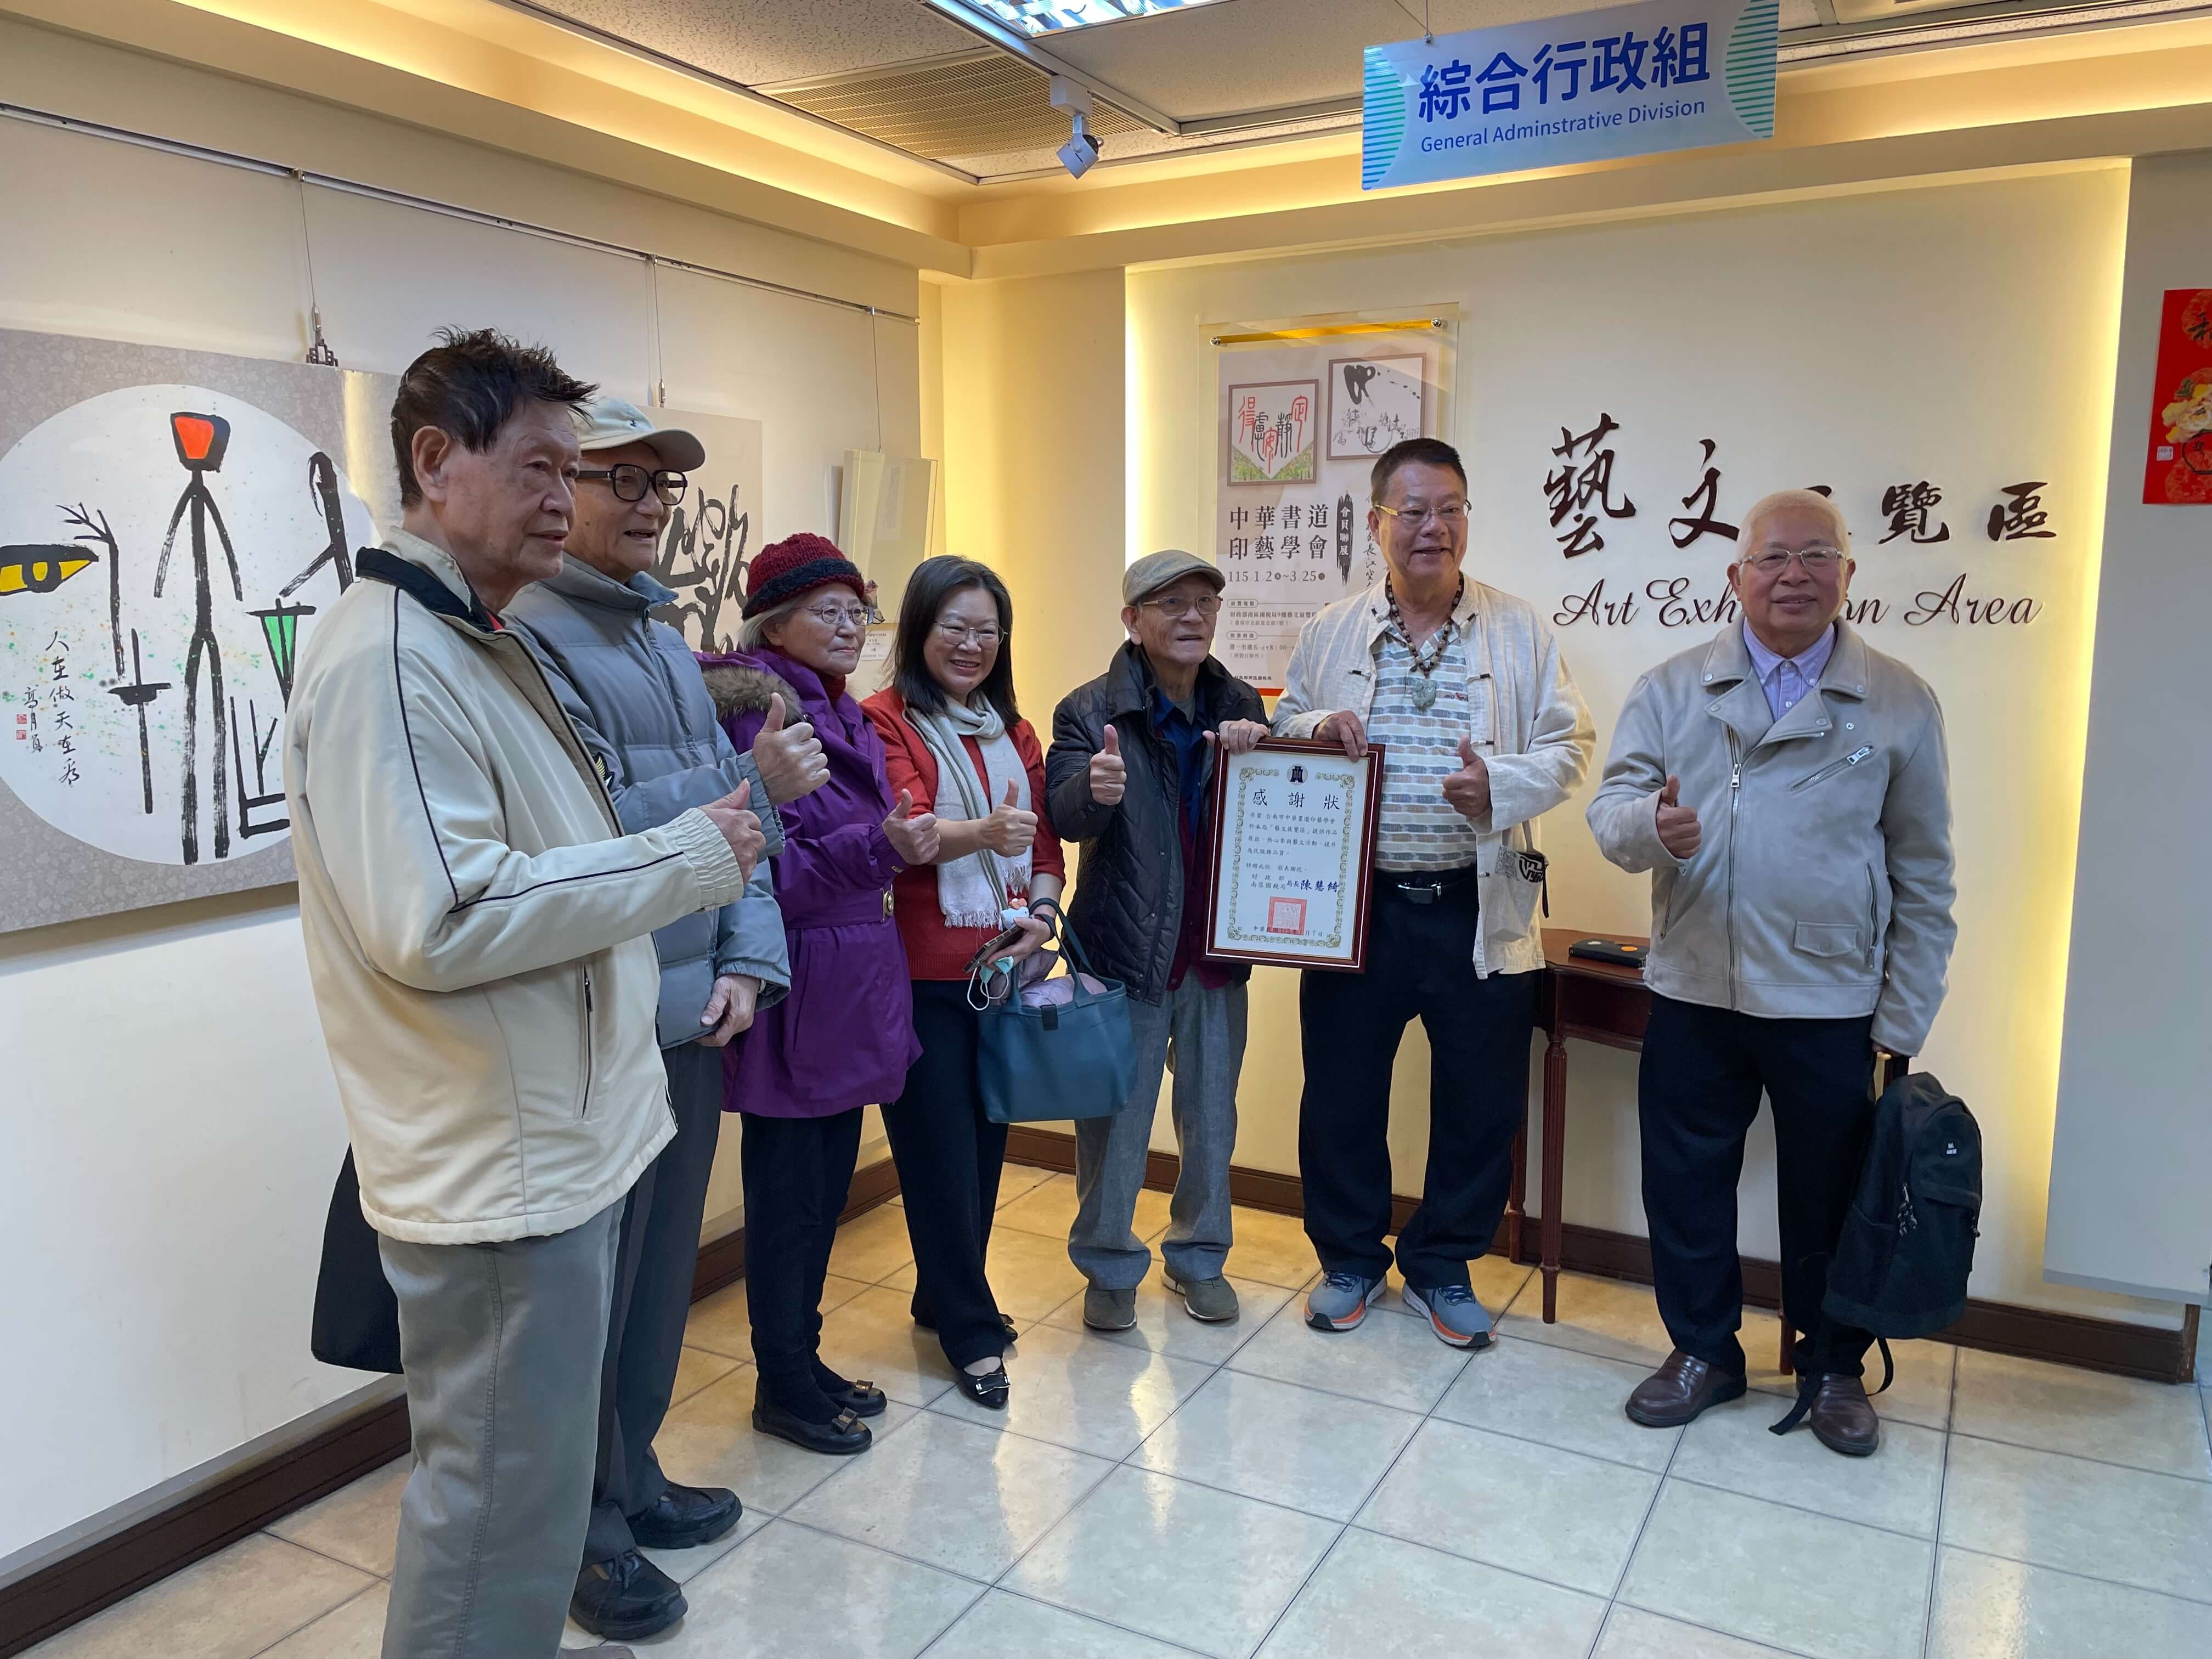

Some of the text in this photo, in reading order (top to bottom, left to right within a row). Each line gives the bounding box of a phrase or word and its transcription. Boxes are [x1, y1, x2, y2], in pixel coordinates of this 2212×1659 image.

[1418, 22, 1710, 123] 綜合行政組
[1421, 98, 1706, 153] General Adminstrative Division
[1543, 412, 2058, 559] 藝文覽區
[1229, 504, 1329, 531] 中華書道
[1229, 534, 1327, 560] 印藝學會
[1552, 579, 1640, 627] Art
[1903, 572, 2044, 626] Area
